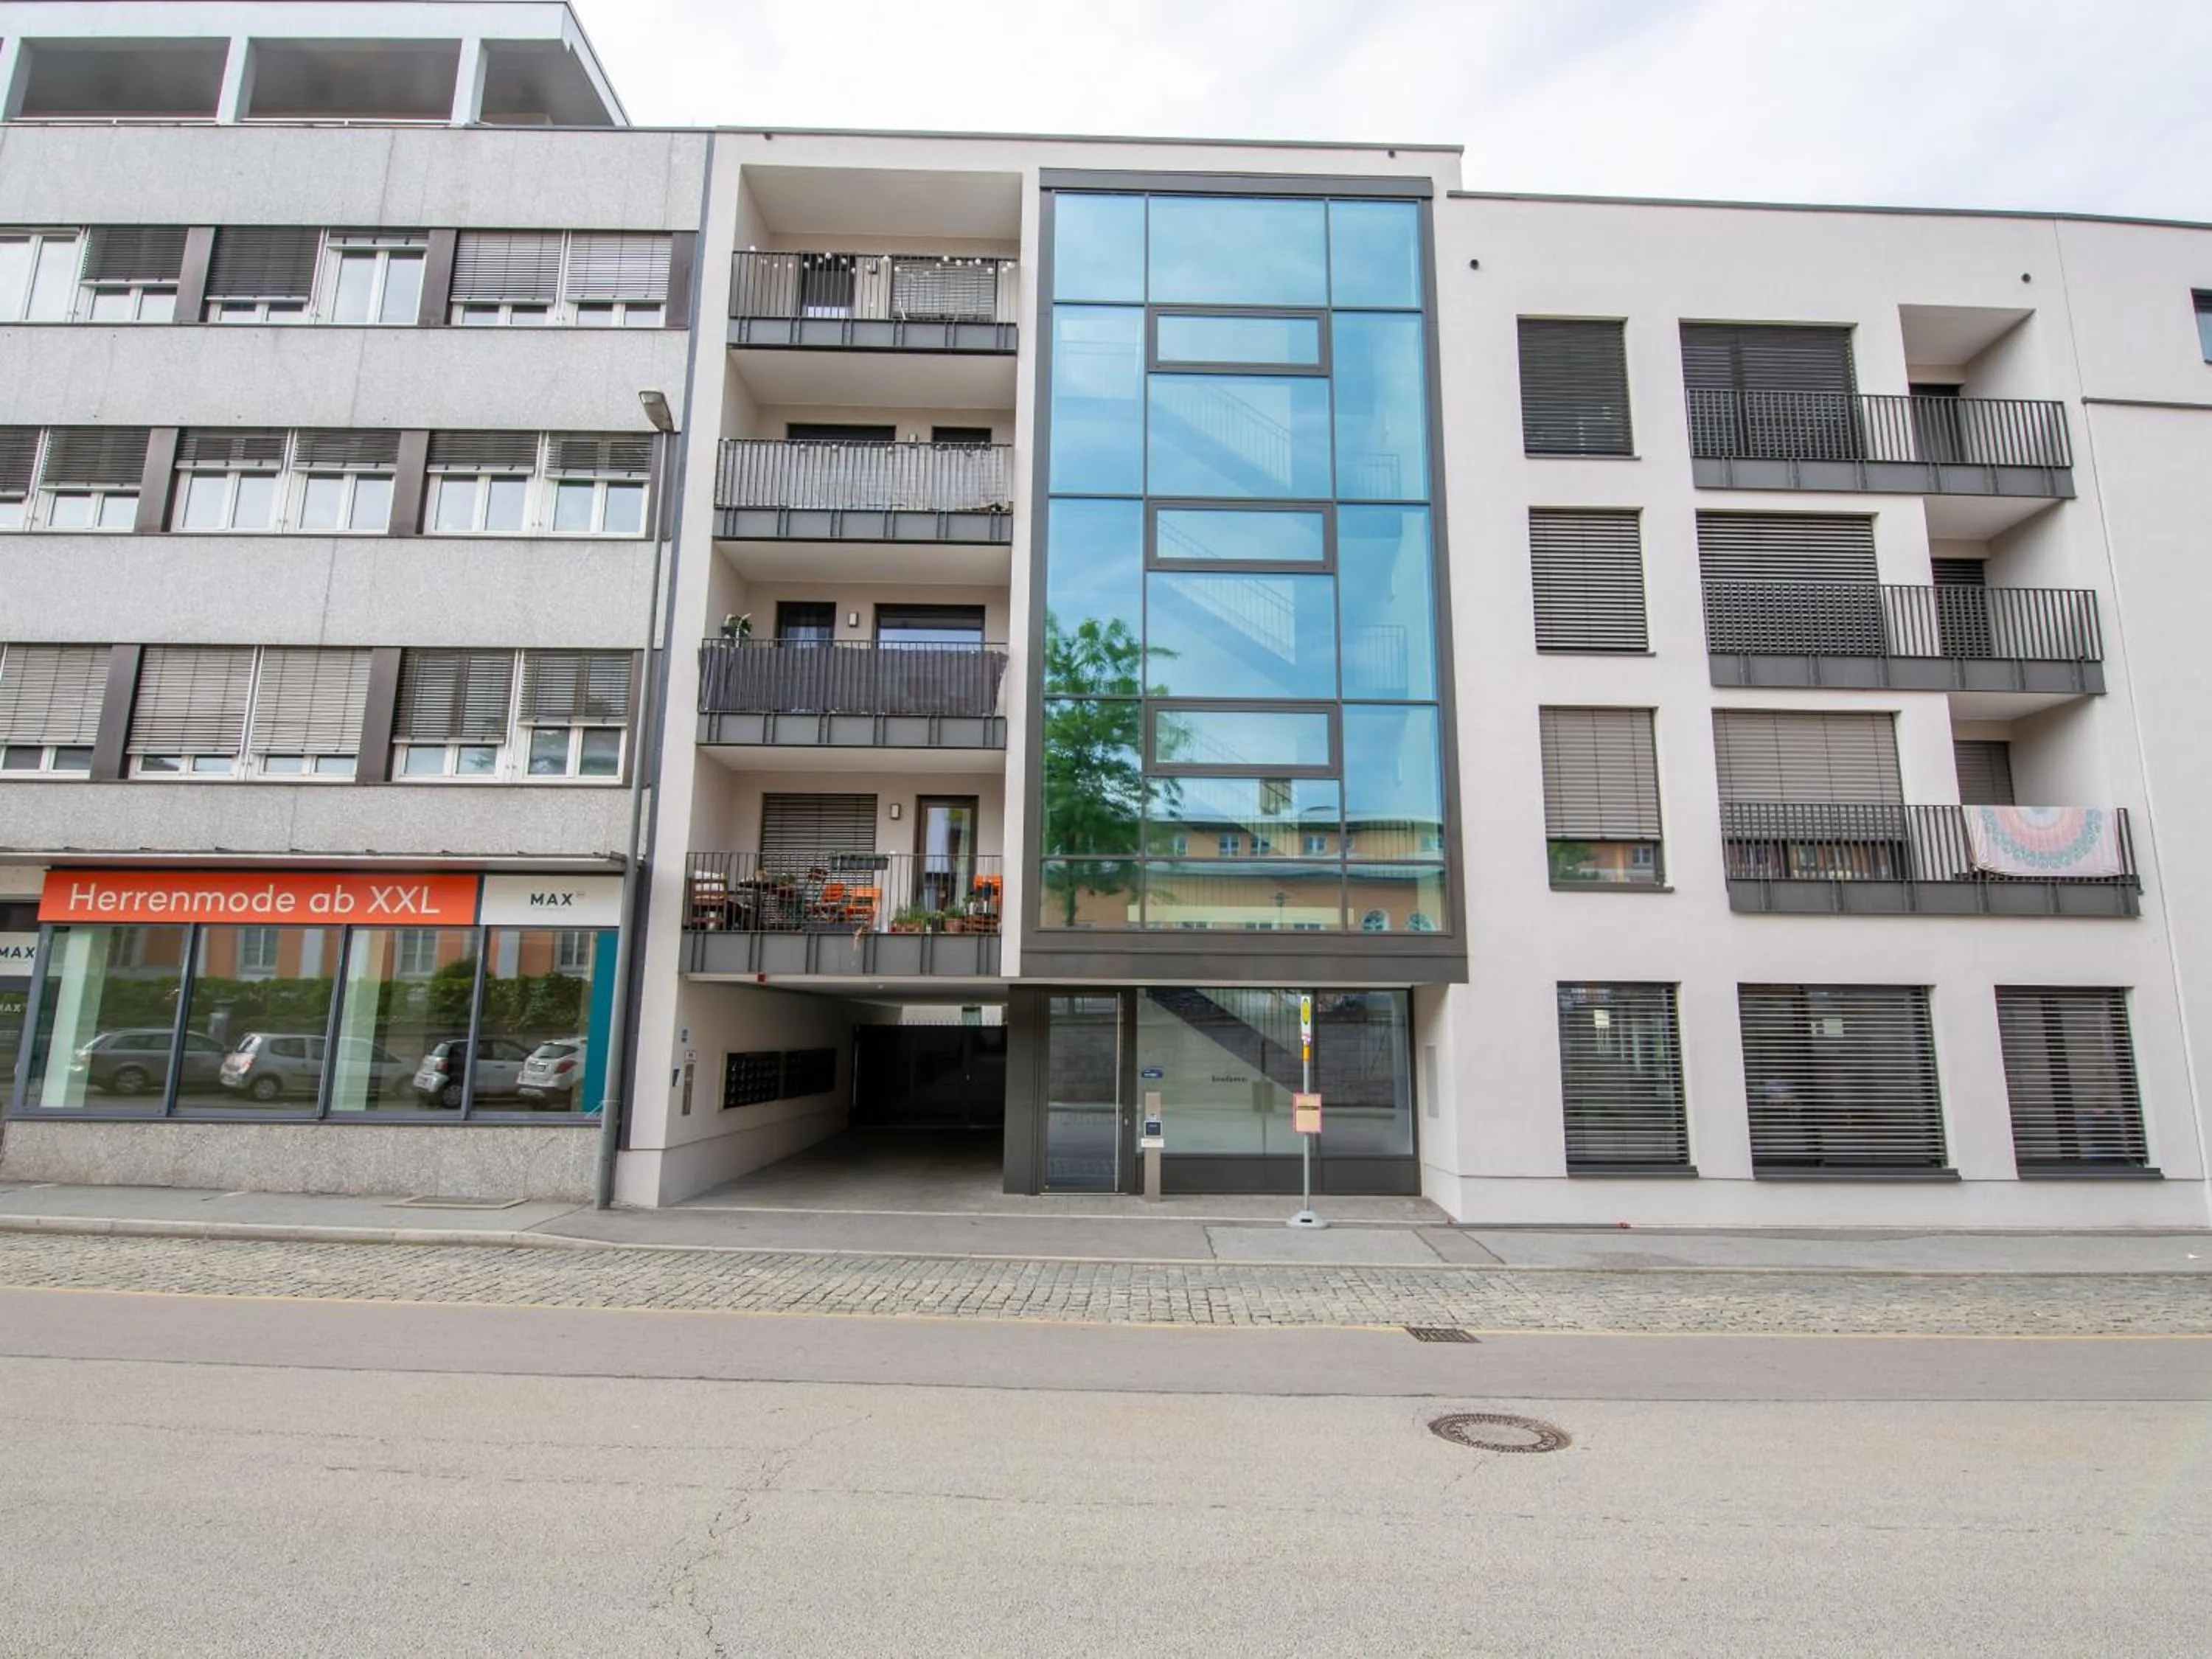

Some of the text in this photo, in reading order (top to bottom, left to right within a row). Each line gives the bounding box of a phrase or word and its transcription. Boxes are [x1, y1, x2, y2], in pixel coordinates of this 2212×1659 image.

[69, 883, 440, 914] Herrenmode ab XXL
[530, 892, 574, 906] MAX
[0, 946, 35, 959] MAX
